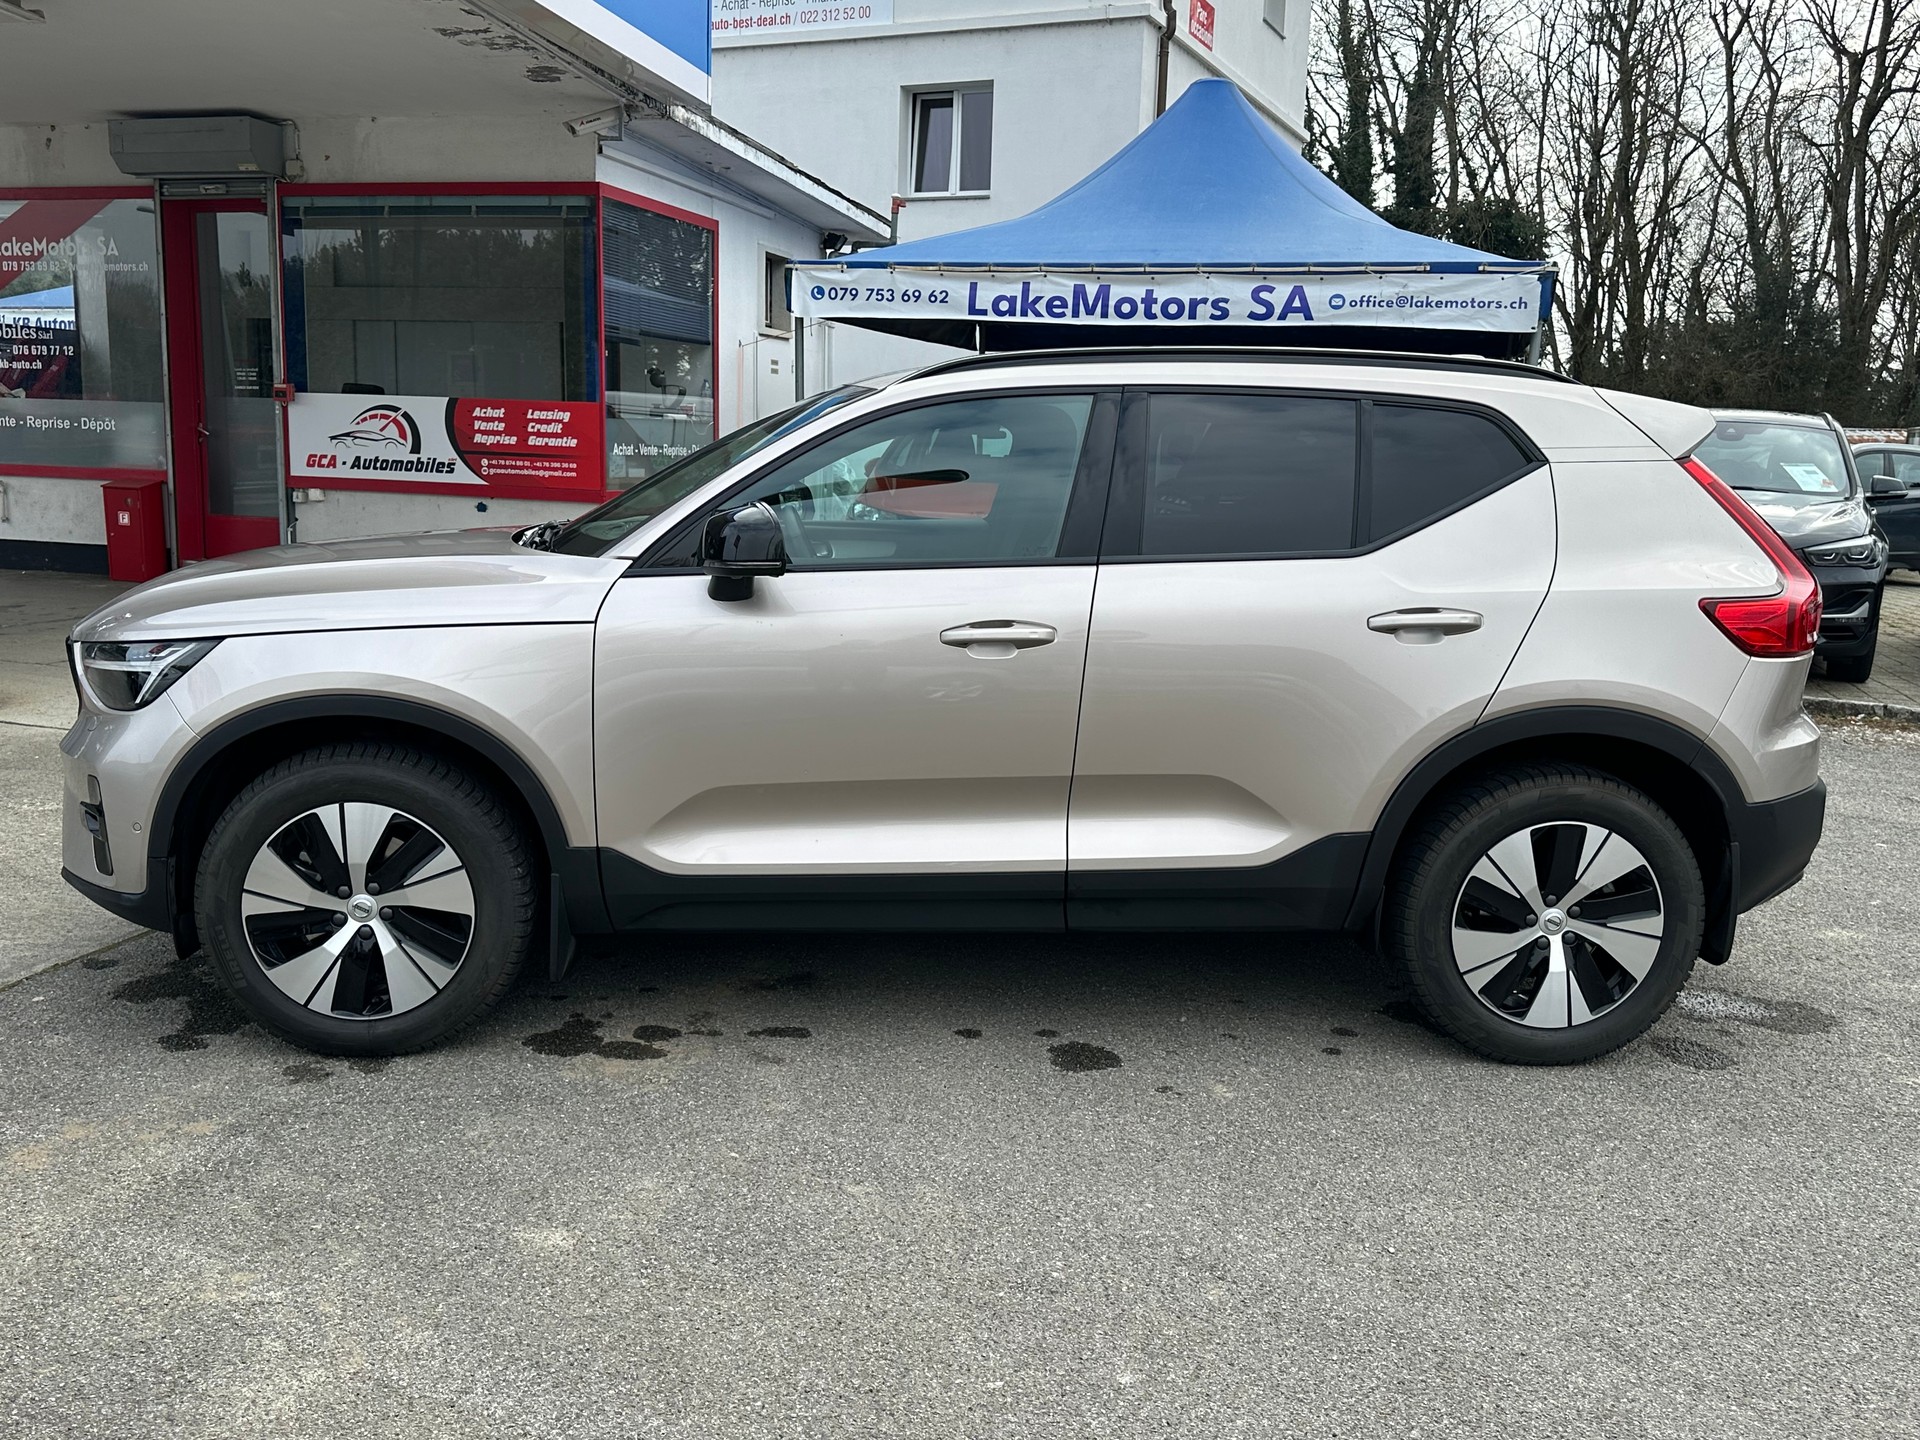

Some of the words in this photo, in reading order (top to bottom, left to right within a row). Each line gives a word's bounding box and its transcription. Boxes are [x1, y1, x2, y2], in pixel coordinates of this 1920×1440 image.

[800, 11, 818, 24] 022
[821, 9, 840, 22] 312
[843, 7, 855, 20] 52
[858, 5, 871, 18] 00
[2, 261, 18, 271] 079
[20, 261, 35, 271] 753
[828, 286, 859, 301] 079
[865, 287, 895, 302] 753
[901, 289, 922, 303] 69
[928, 289, 949, 304] 62
[967, 281, 1231, 320] LakeMotors
[1247, 284, 1314, 321] SA
[1349, 294, 1528, 310] office@lakemotors.ch
[0, 321, 37, 339] biles
[13, 344, 29, 355] 076
[31, 344, 48, 355] 679
[50, 345, 60, 355] 77
[63, 345, 74, 356] 12
[472, 407, 505, 418] Achat
[527, 409, 571, 422] Leasing
[26, 415, 70, 431] Reprise
[81, 417, 116, 433] Dépôt
[474, 420, 505, 431] Vente
[527, 422, 563, 433] Credit
[474, 433, 517, 445] Reprise
[528, 435, 578, 447] Garantie
[612, 442, 634, 455] Achat
[639, 443, 658, 456] Vente
[663, 443, 687, 458] Reprise
[306, 453, 337, 469] GCA
[349, 455, 456, 474] Automobiles
